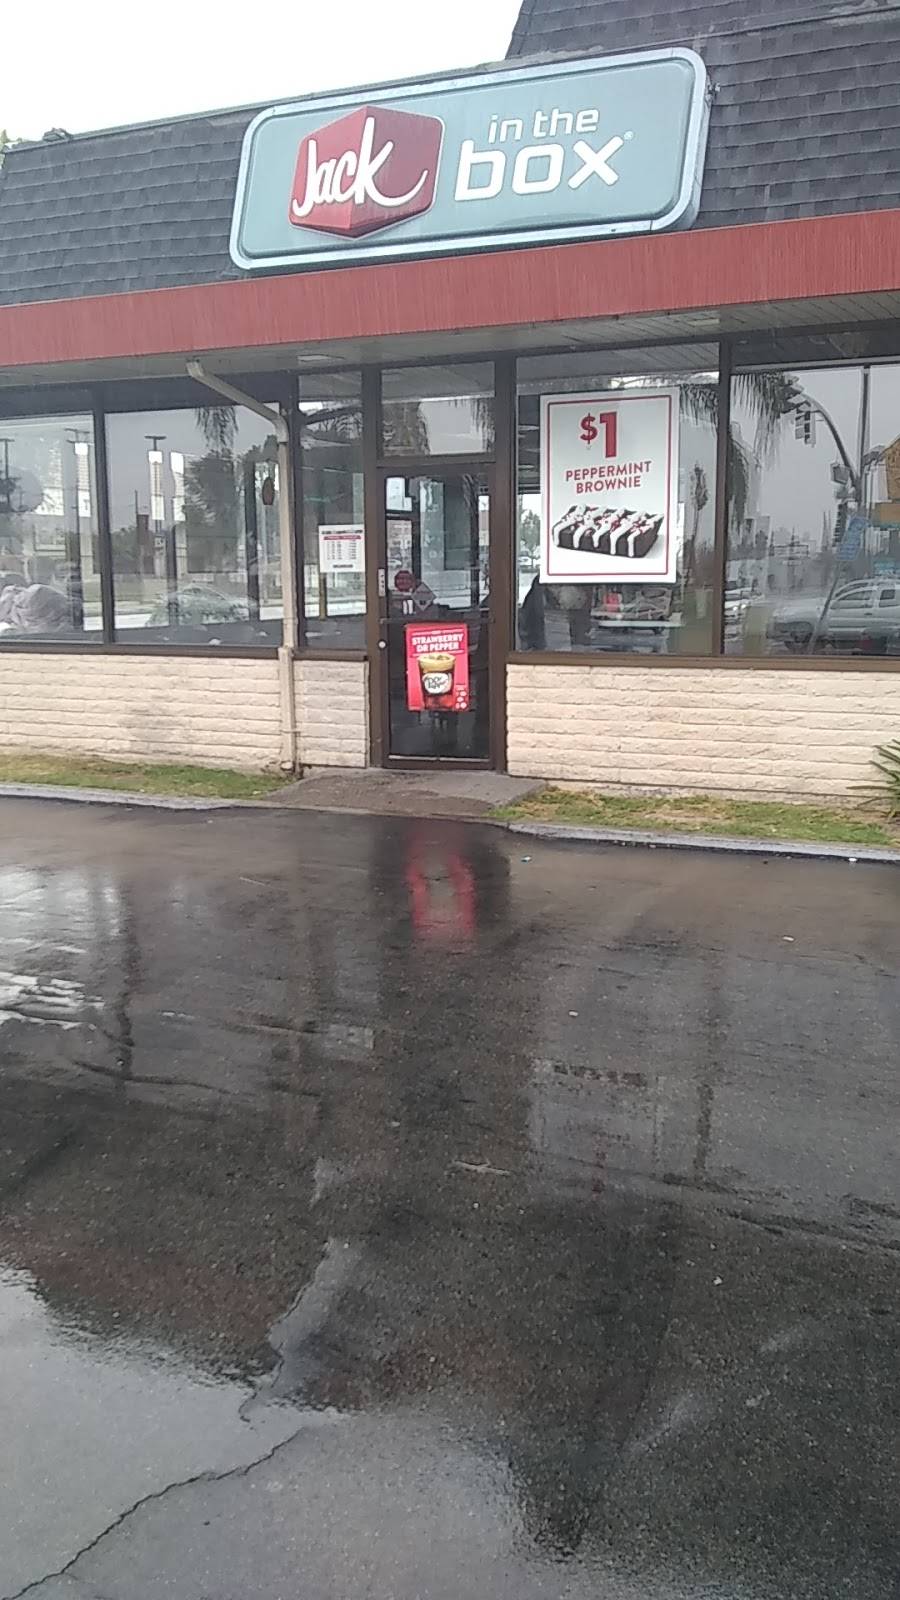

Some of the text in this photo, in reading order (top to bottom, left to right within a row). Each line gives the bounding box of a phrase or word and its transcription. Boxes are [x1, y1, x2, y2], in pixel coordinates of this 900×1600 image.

[488, 108, 600, 144] in the
[292, 116, 428, 217] Jack
[454, 135, 624, 202] box
[579, 411, 618, 459] $1
[566, 460, 652, 482] PEPPERMINT
[576, 475, 642, 494] BROWNIE
[411, 632, 464, 646] STRAWBERRY
[429, 641, 460, 652] PEPPER
